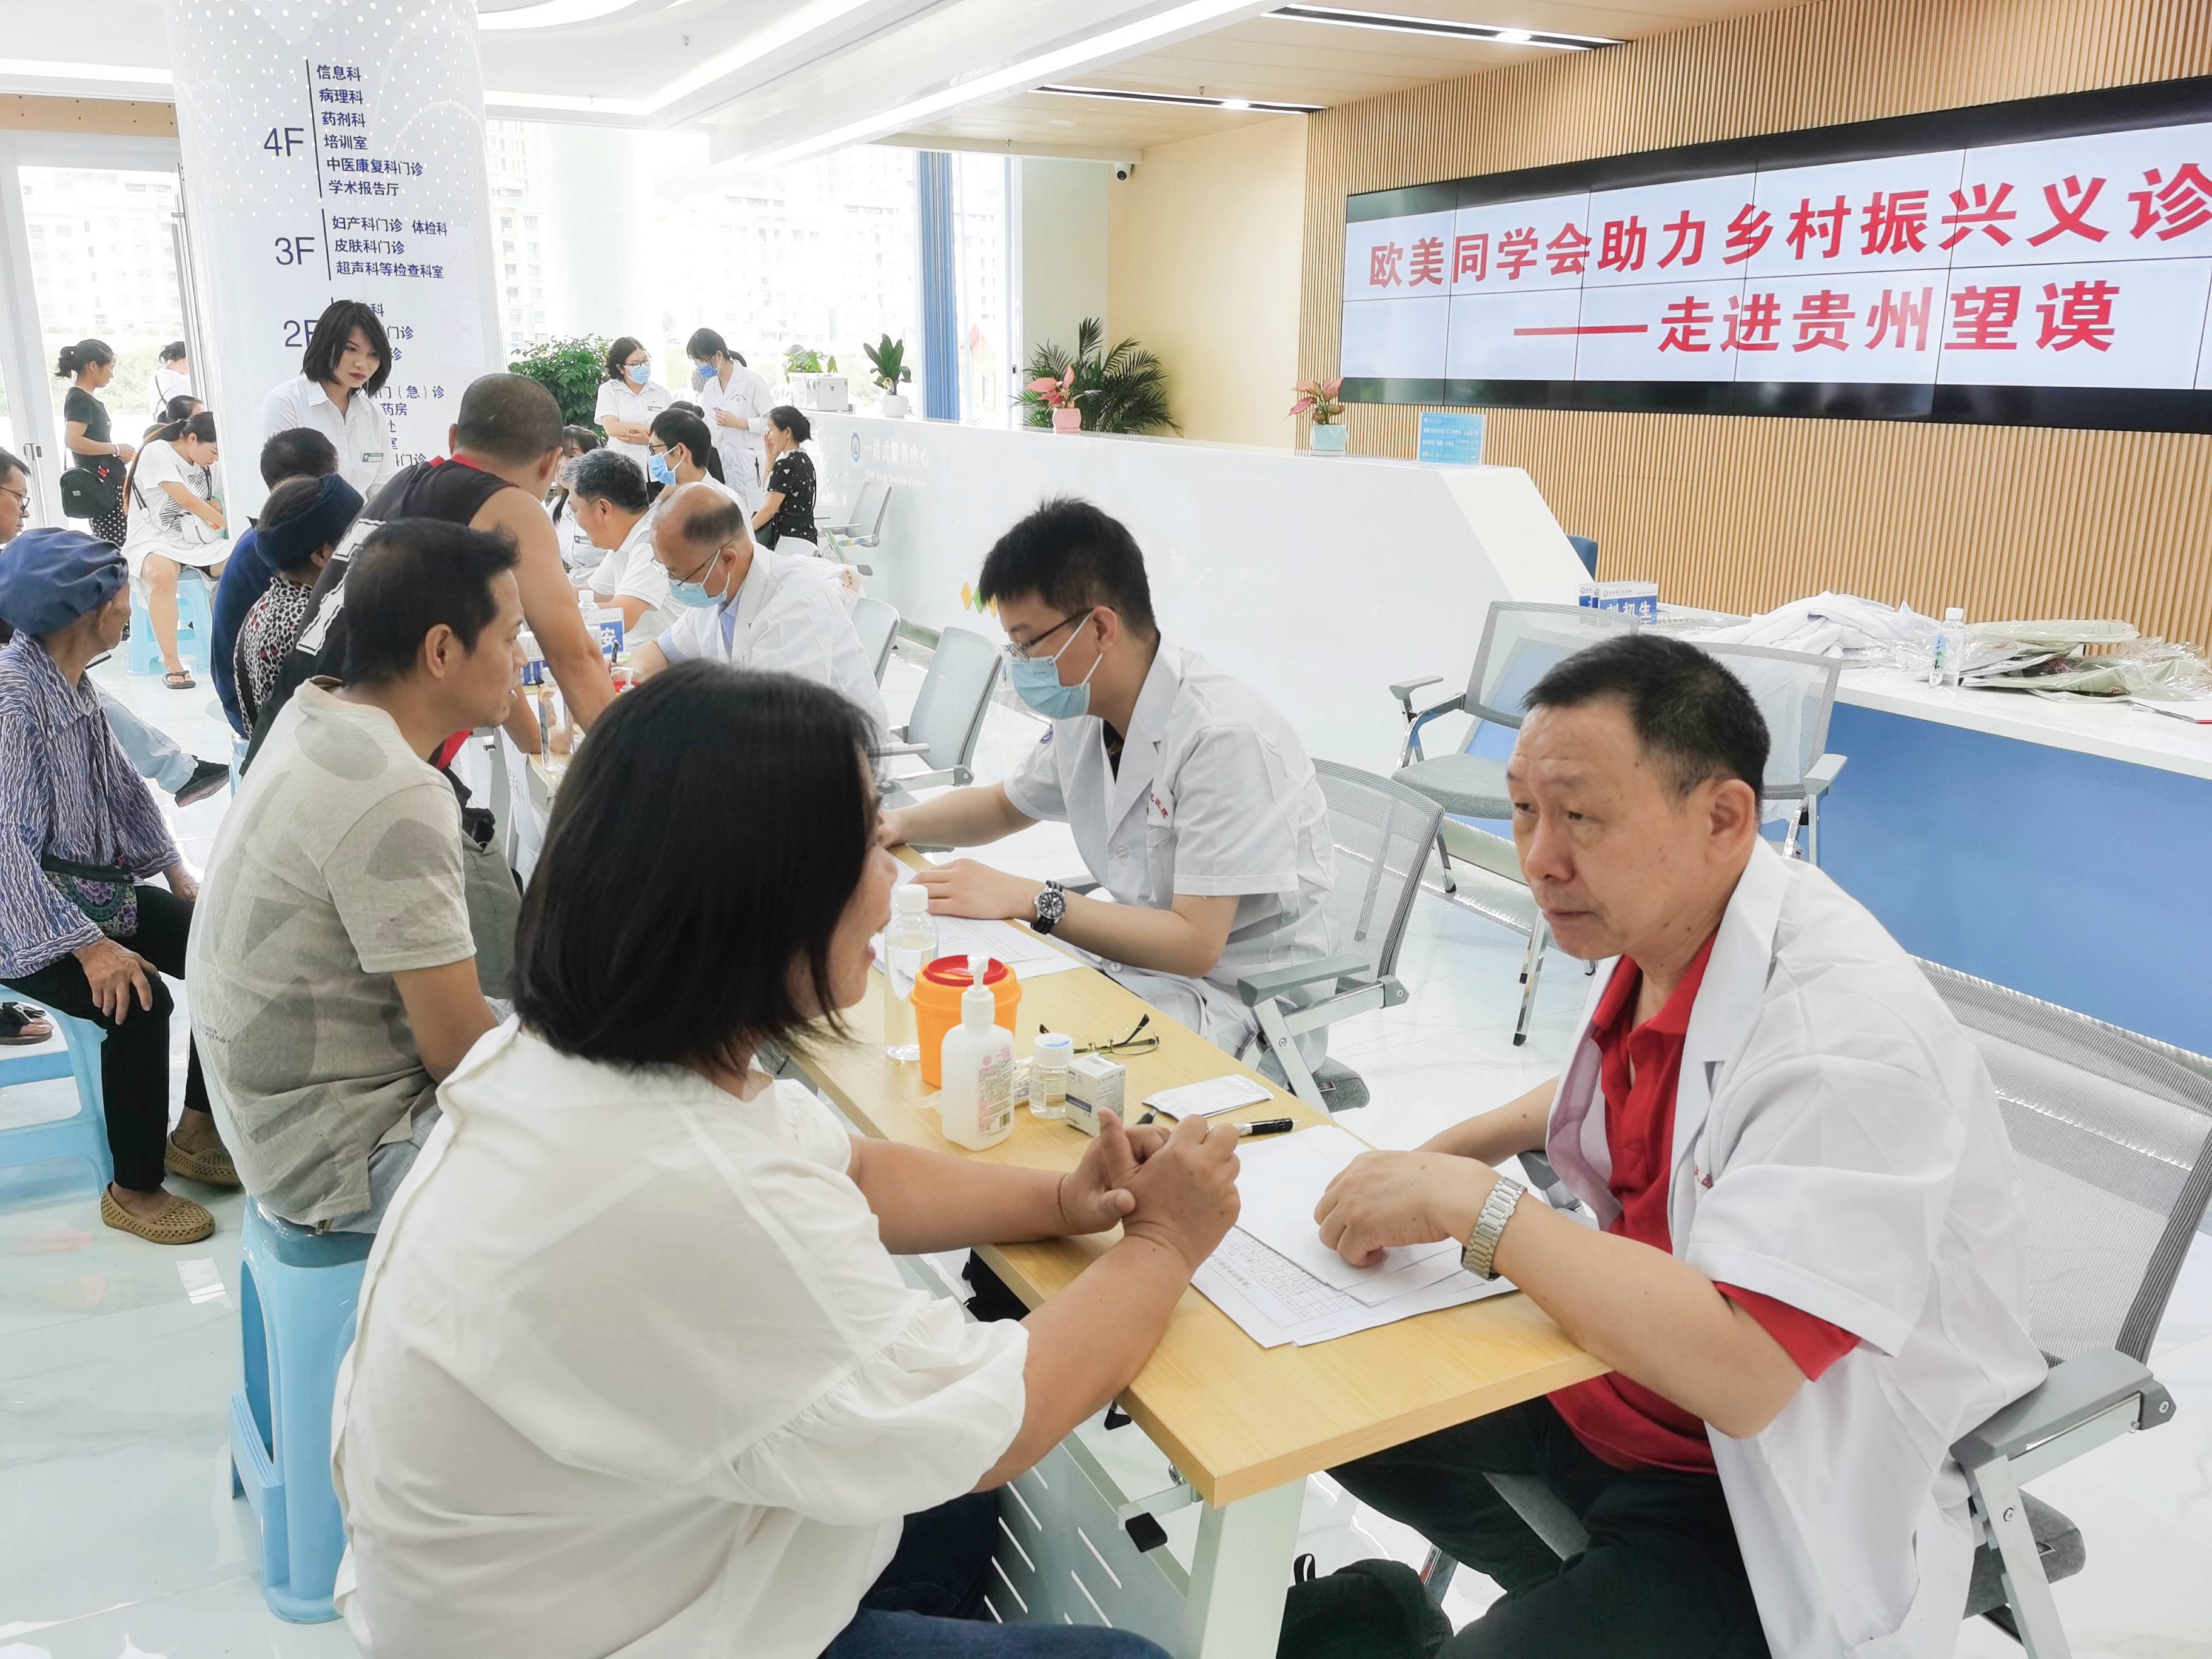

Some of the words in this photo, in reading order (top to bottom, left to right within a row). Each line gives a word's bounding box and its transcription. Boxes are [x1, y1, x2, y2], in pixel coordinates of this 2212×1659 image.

[317, 64, 361, 82] 信息科
[319, 87, 364, 105] 病理科
[321, 111, 366, 128] 药剂科
[264, 127, 304, 156] 4F
[324, 134, 368, 150] 培训室
[327, 156, 423, 176] 中医康复科门诊
[329, 179, 399, 196] 学术报告厅
[332, 215, 403, 233] 妇产科门诊
[412, 220, 447, 236] 体检科
[1369, 163, 2212, 288] 欧美同学会助力乡村振兴义诊
[275, 236, 315, 266] 3F
[335, 238, 405, 255] 皮肤科门诊
[336, 261, 444, 279] 超声科等检查科室
